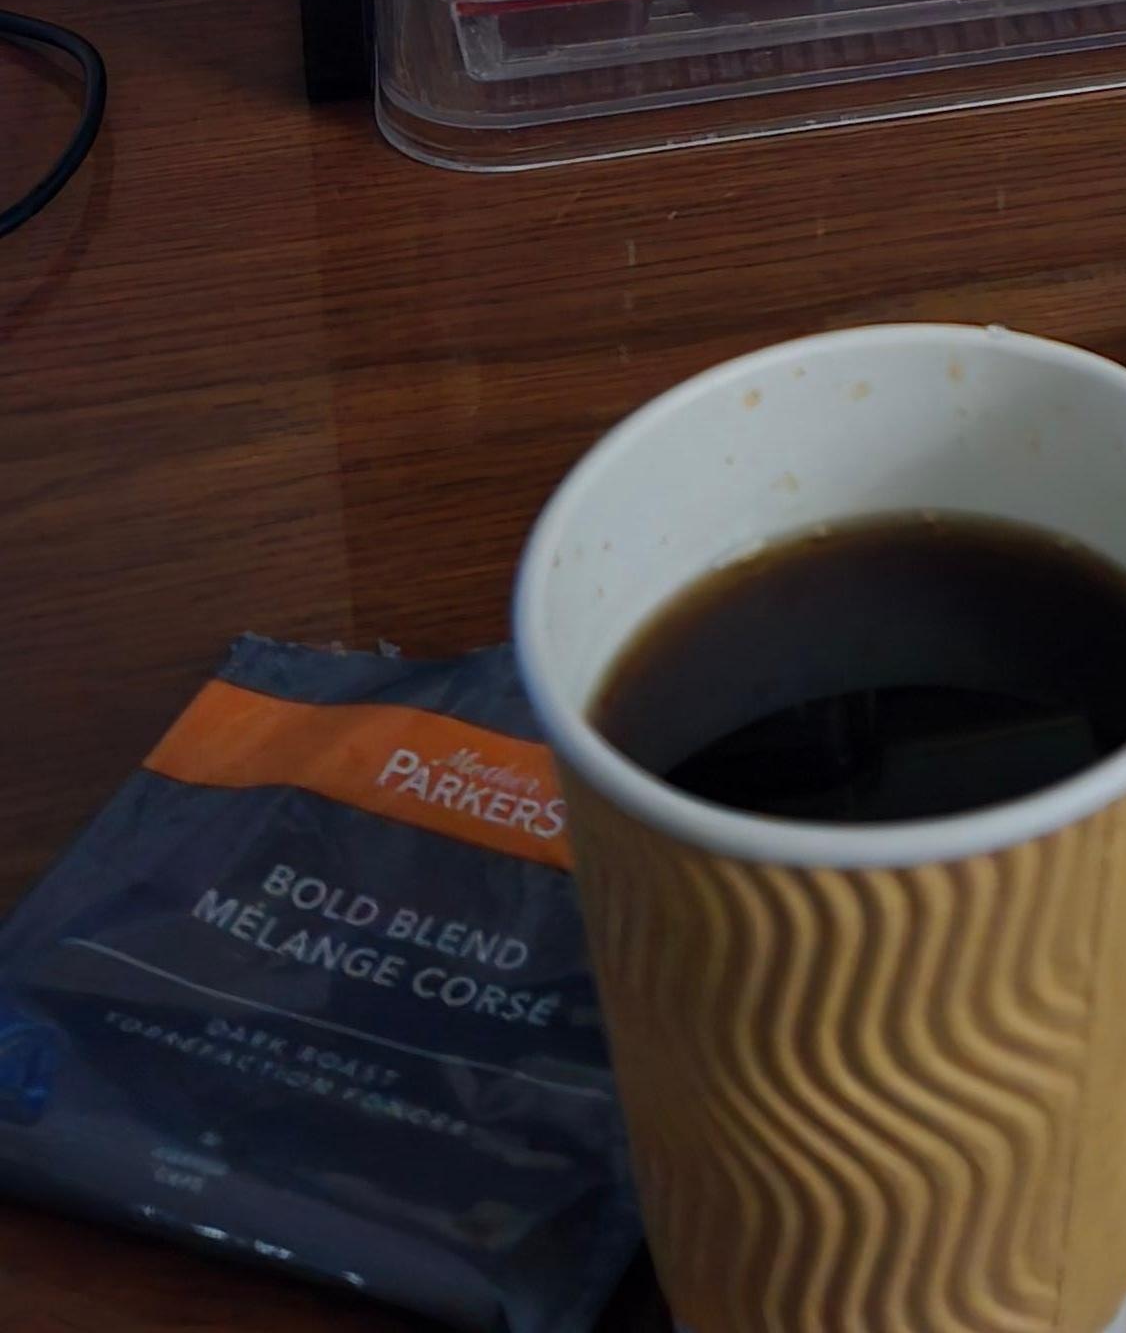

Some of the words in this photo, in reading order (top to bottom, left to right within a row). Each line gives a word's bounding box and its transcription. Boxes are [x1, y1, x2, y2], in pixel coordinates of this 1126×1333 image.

[376, 748, 569, 839] PARKERS
[191, 887, 407, 988] MÉLANGE
[263, 863, 380, 927] BOLD
[385, 908, 528, 971] BLEND
